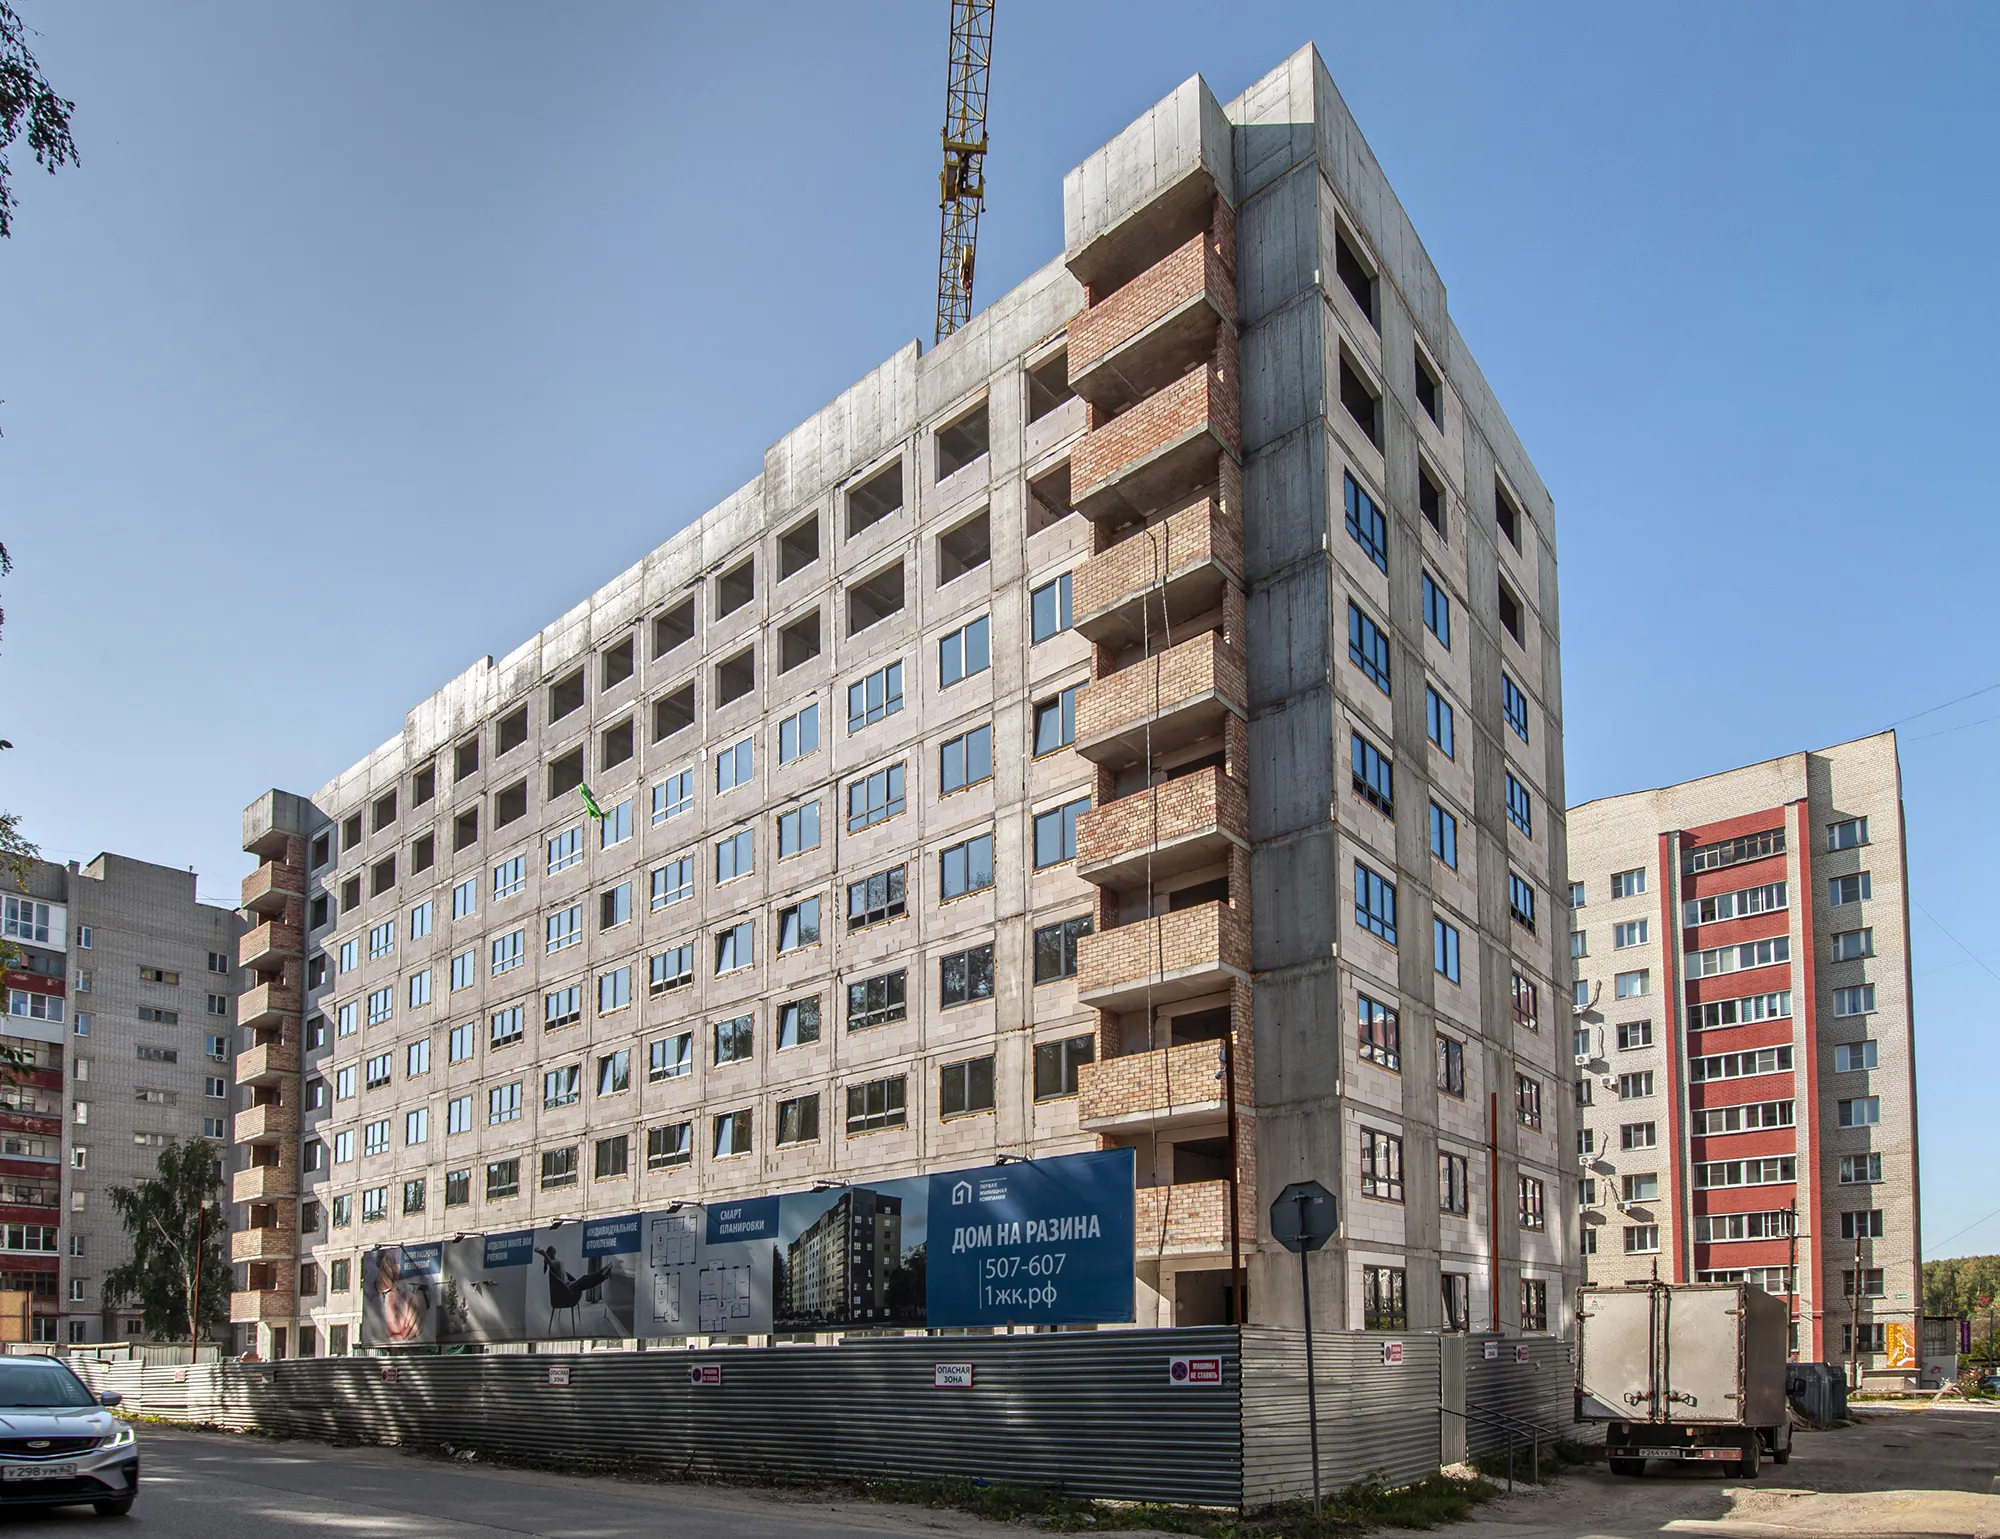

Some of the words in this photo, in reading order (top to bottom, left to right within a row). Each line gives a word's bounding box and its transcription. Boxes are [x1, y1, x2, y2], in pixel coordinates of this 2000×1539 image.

[720, 1208, 742, 1221] СМАРТ
[586, 1222, 638, 1238] ИНДИВИДУАЛЬНОЕ
[720, 1220, 765, 1234] ПЛАНИРОВКИ
[952, 1225, 992, 1254] ДОМ
[997, 1222, 1021, 1246] НА
[1026, 1215, 1101, 1243] РАЗИНА
[586, 1237, 617, 1249] ОТОПЛЕНИЕ
[985, 1253, 1066, 1279] 507-607
[985, 1280, 1057, 1309] 1жк.рф
[937, 1366, 970, 1374] ОПАСНАЯ
[943, 1376, 963, 1384] ЗОНА
